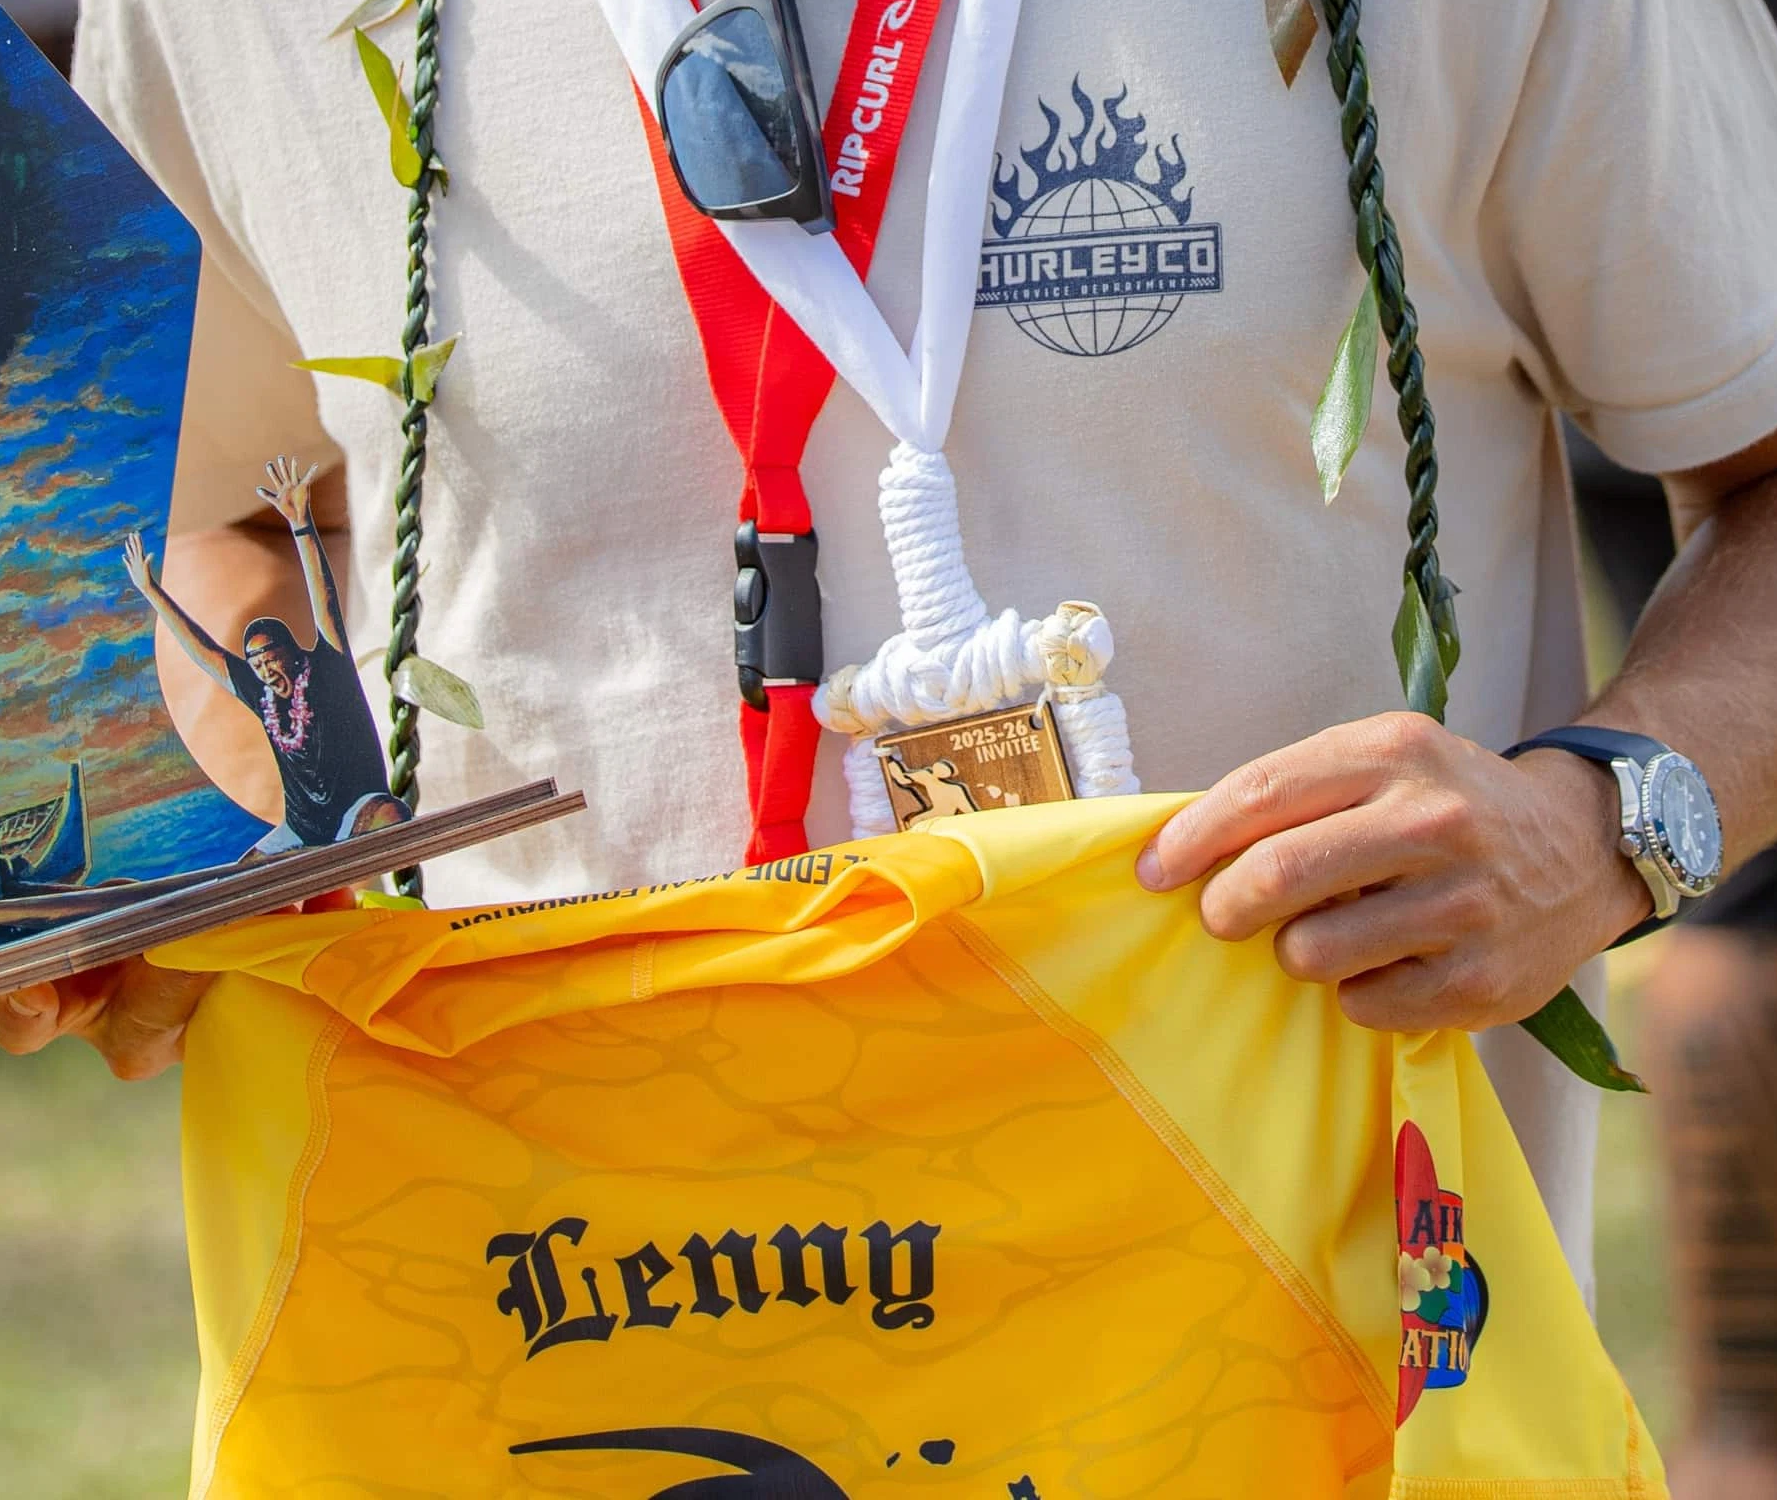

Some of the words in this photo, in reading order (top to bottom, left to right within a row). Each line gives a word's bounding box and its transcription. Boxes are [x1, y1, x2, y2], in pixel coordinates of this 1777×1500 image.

[1003, 285, 1070, 301] SERVICE
[1081, 278, 1186, 296] DEPARTMENT
[950, 719, 1029, 751] 2025-26
[975, 734, 1042, 764] INVITEE
[745, 853, 834, 886] EDDIE
[485, 1216, 942, 1362] Lenny
